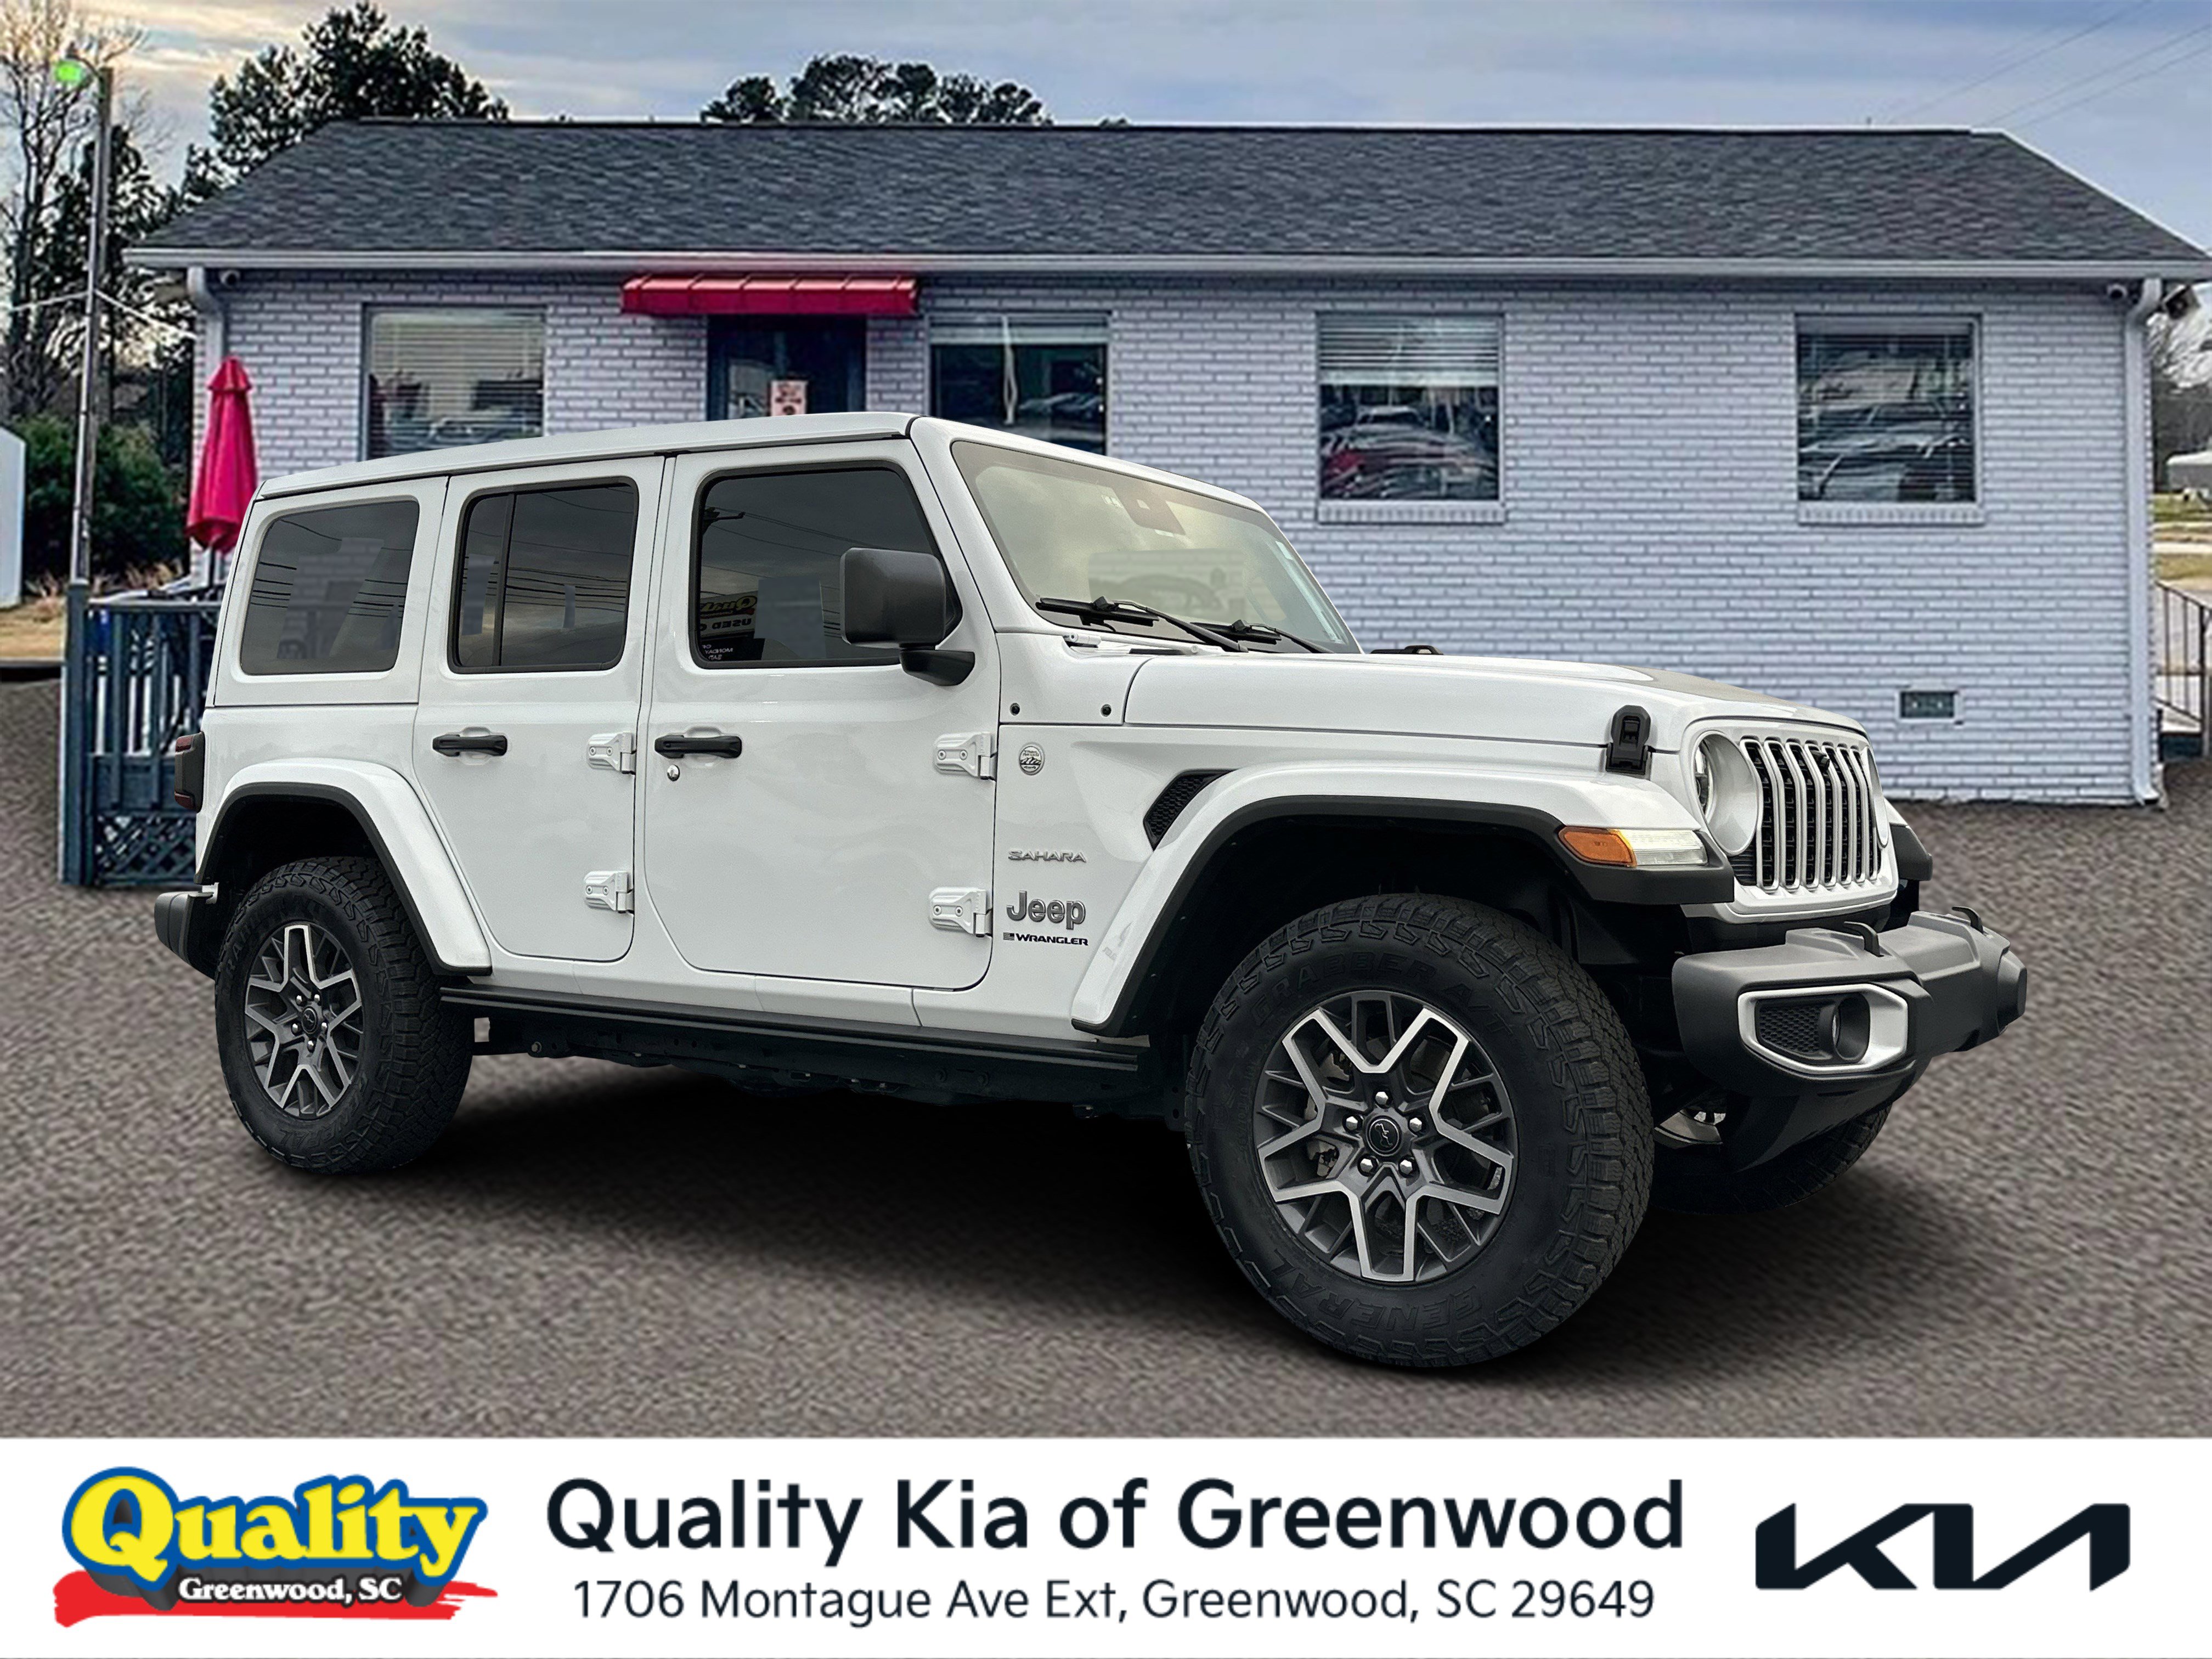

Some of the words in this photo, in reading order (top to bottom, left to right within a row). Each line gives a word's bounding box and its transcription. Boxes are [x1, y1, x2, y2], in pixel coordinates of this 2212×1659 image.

[1008, 851, 1086, 862] SAHARA
[1007, 890, 1086, 930] Jeep
[1015, 933, 1088, 945] WRANGLER
[1250, 951, 1437, 1023] GRABBER
[1272, 1249, 1480, 1331] GENERAL
